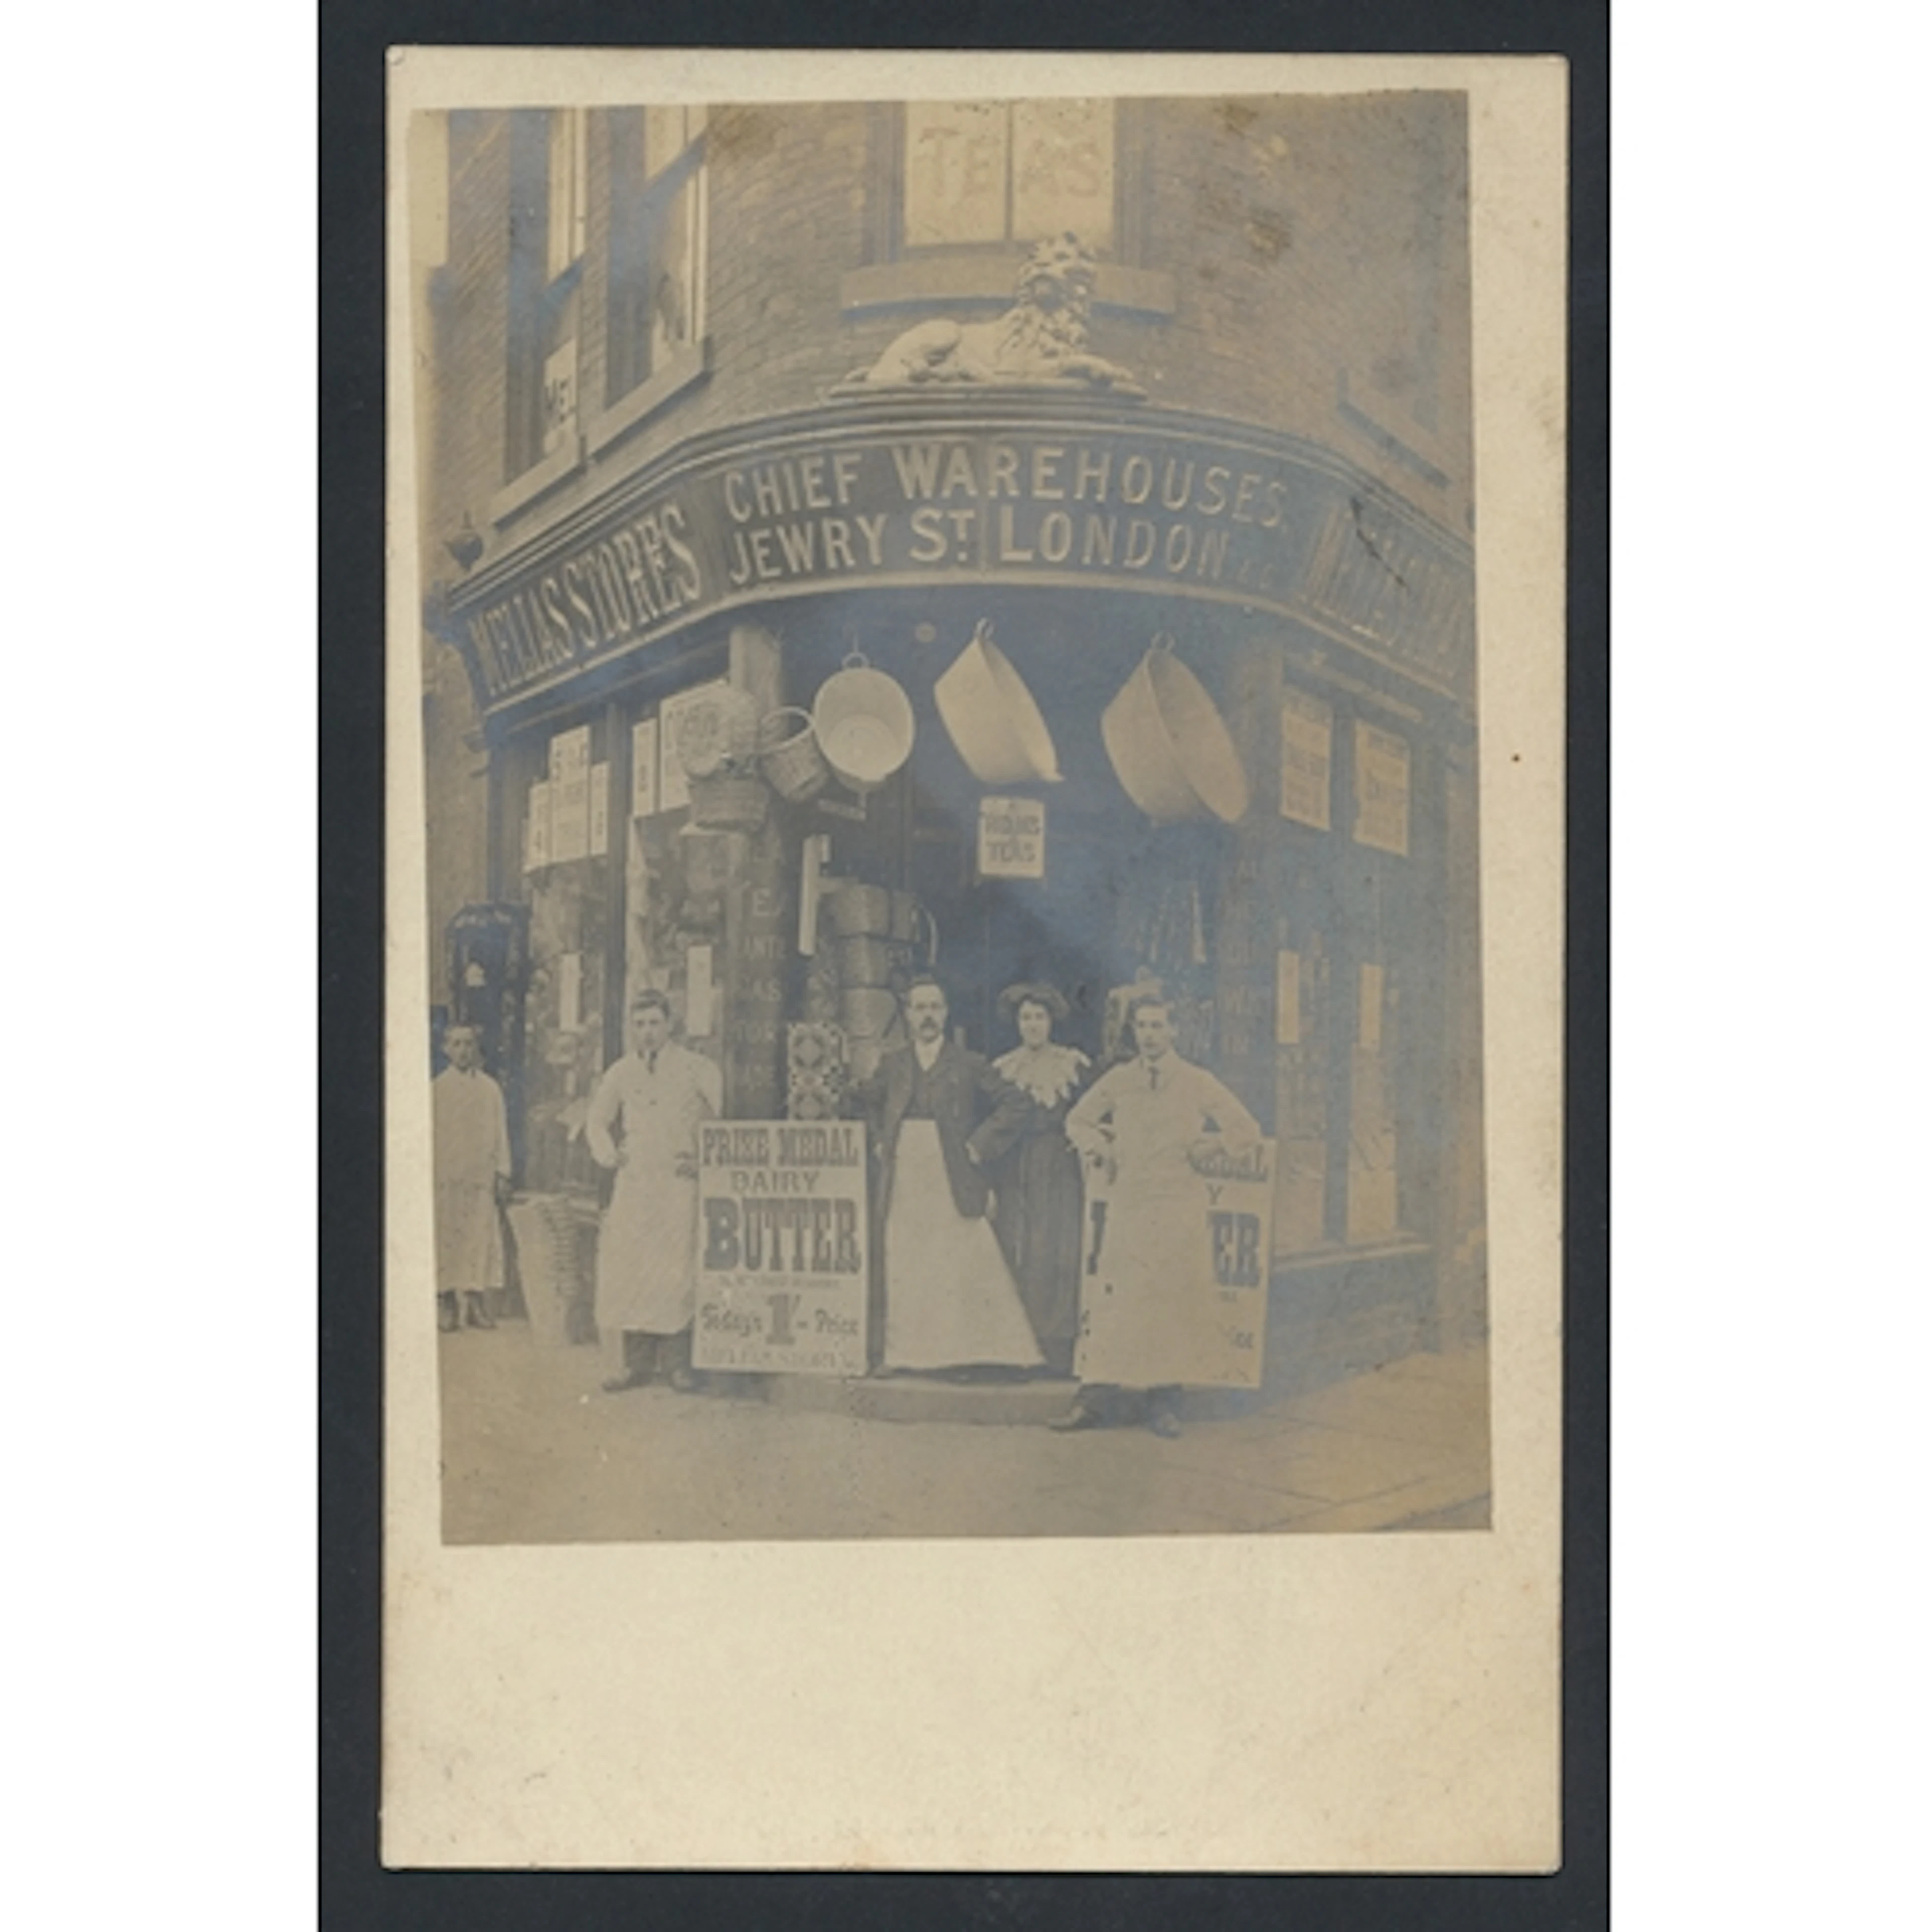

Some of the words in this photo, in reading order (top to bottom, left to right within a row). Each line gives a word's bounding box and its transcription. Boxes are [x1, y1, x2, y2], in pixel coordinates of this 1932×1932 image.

[918, 127, 1102, 198] TEAS
[723, 452, 862, 524] CHIEF
[558, 501, 703, 652] STORES
[729, 512, 890, 585] JEWRY
[998, 503, 1232, 581] LONDON
[703, 1127, 770, 1167] PRIZE
[777, 1127, 860, 1167] MEDAL
[730, 1169, 820, 1194] DAIRY
[703, 1197, 862, 1275] BUTTER
